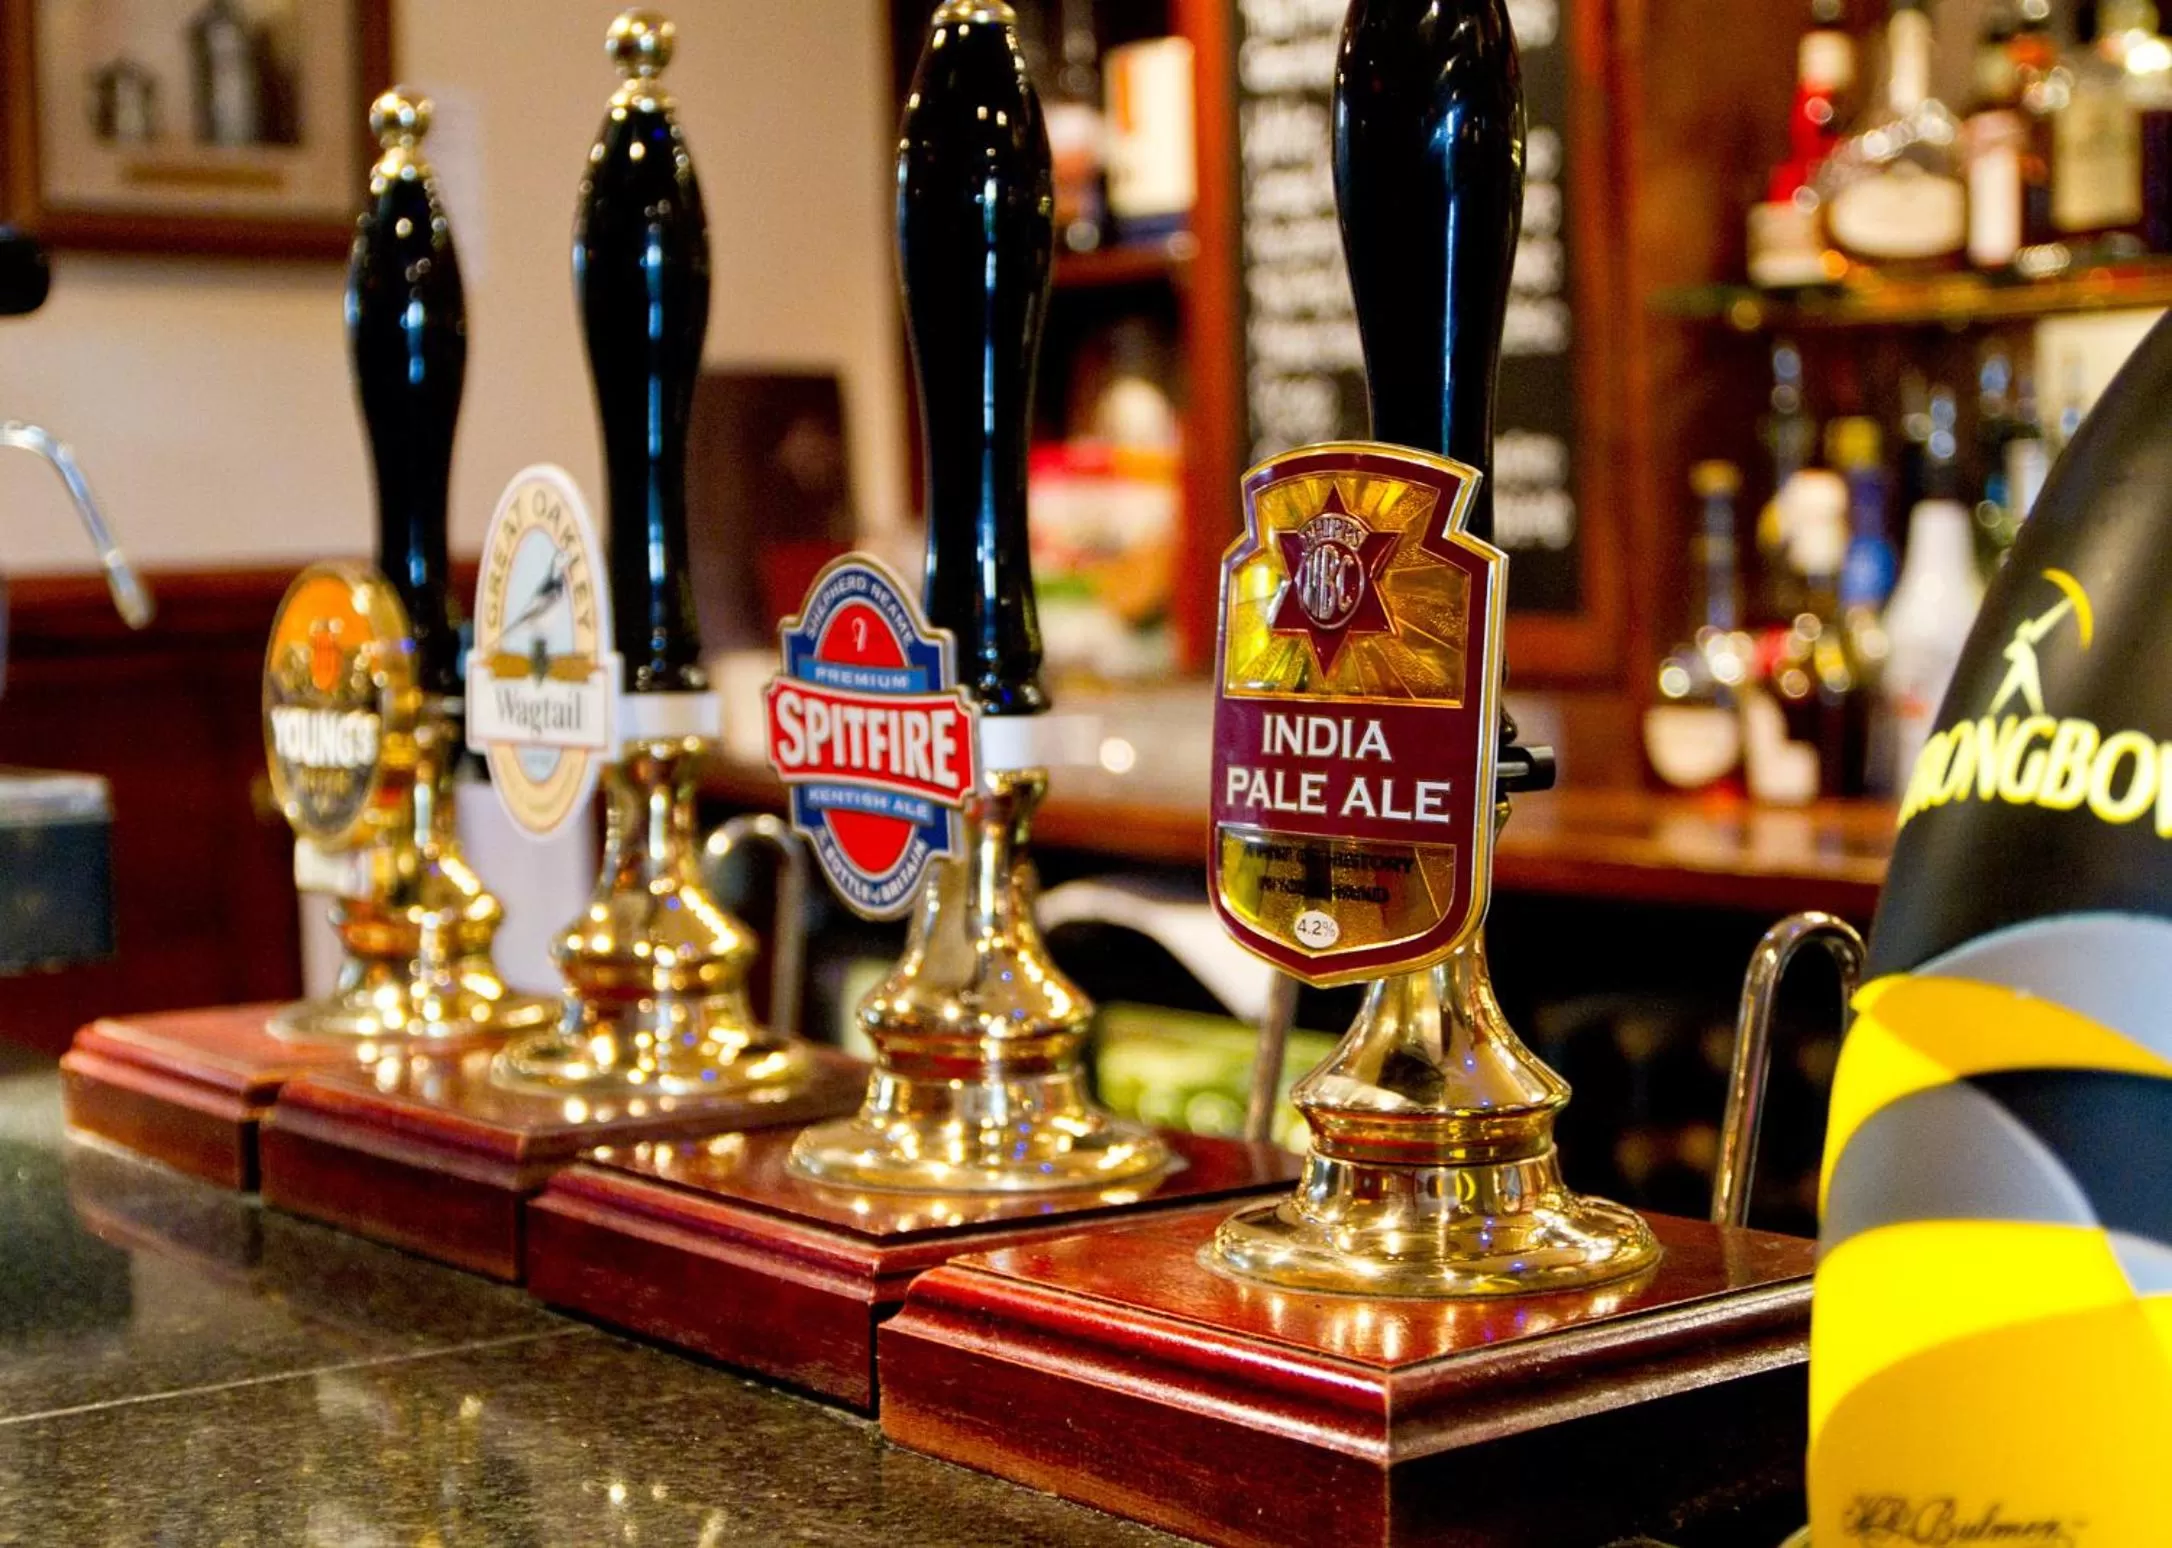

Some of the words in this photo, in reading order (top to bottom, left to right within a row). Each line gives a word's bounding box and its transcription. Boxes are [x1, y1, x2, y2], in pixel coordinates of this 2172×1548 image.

[487, 496, 522, 630] GREAT
[532, 489, 592, 632] OAKLEY
[805, 575, 867, 641] SHEPHERD
[870, 583, 915, 648] NEAME
[815, 666, 910, 689] PREMIUM
[496, 687, 582, 736] Wagtail
[1262, 712, 1393, 762] INDIA
[776, 691, 961, 790] SPITFIRE
[808, 788, 888, 811] KENTISH
[892, 799, 929, 820] ALE
[1225, 766, 1329, 816] PALE
[1340, 776, 1451, 824] ALE
[824, 844, 868, 901] BOTTLE
[879, 838, 928, 902] BRITAIN
[1297, 919, 1336, 938] 4.2%
